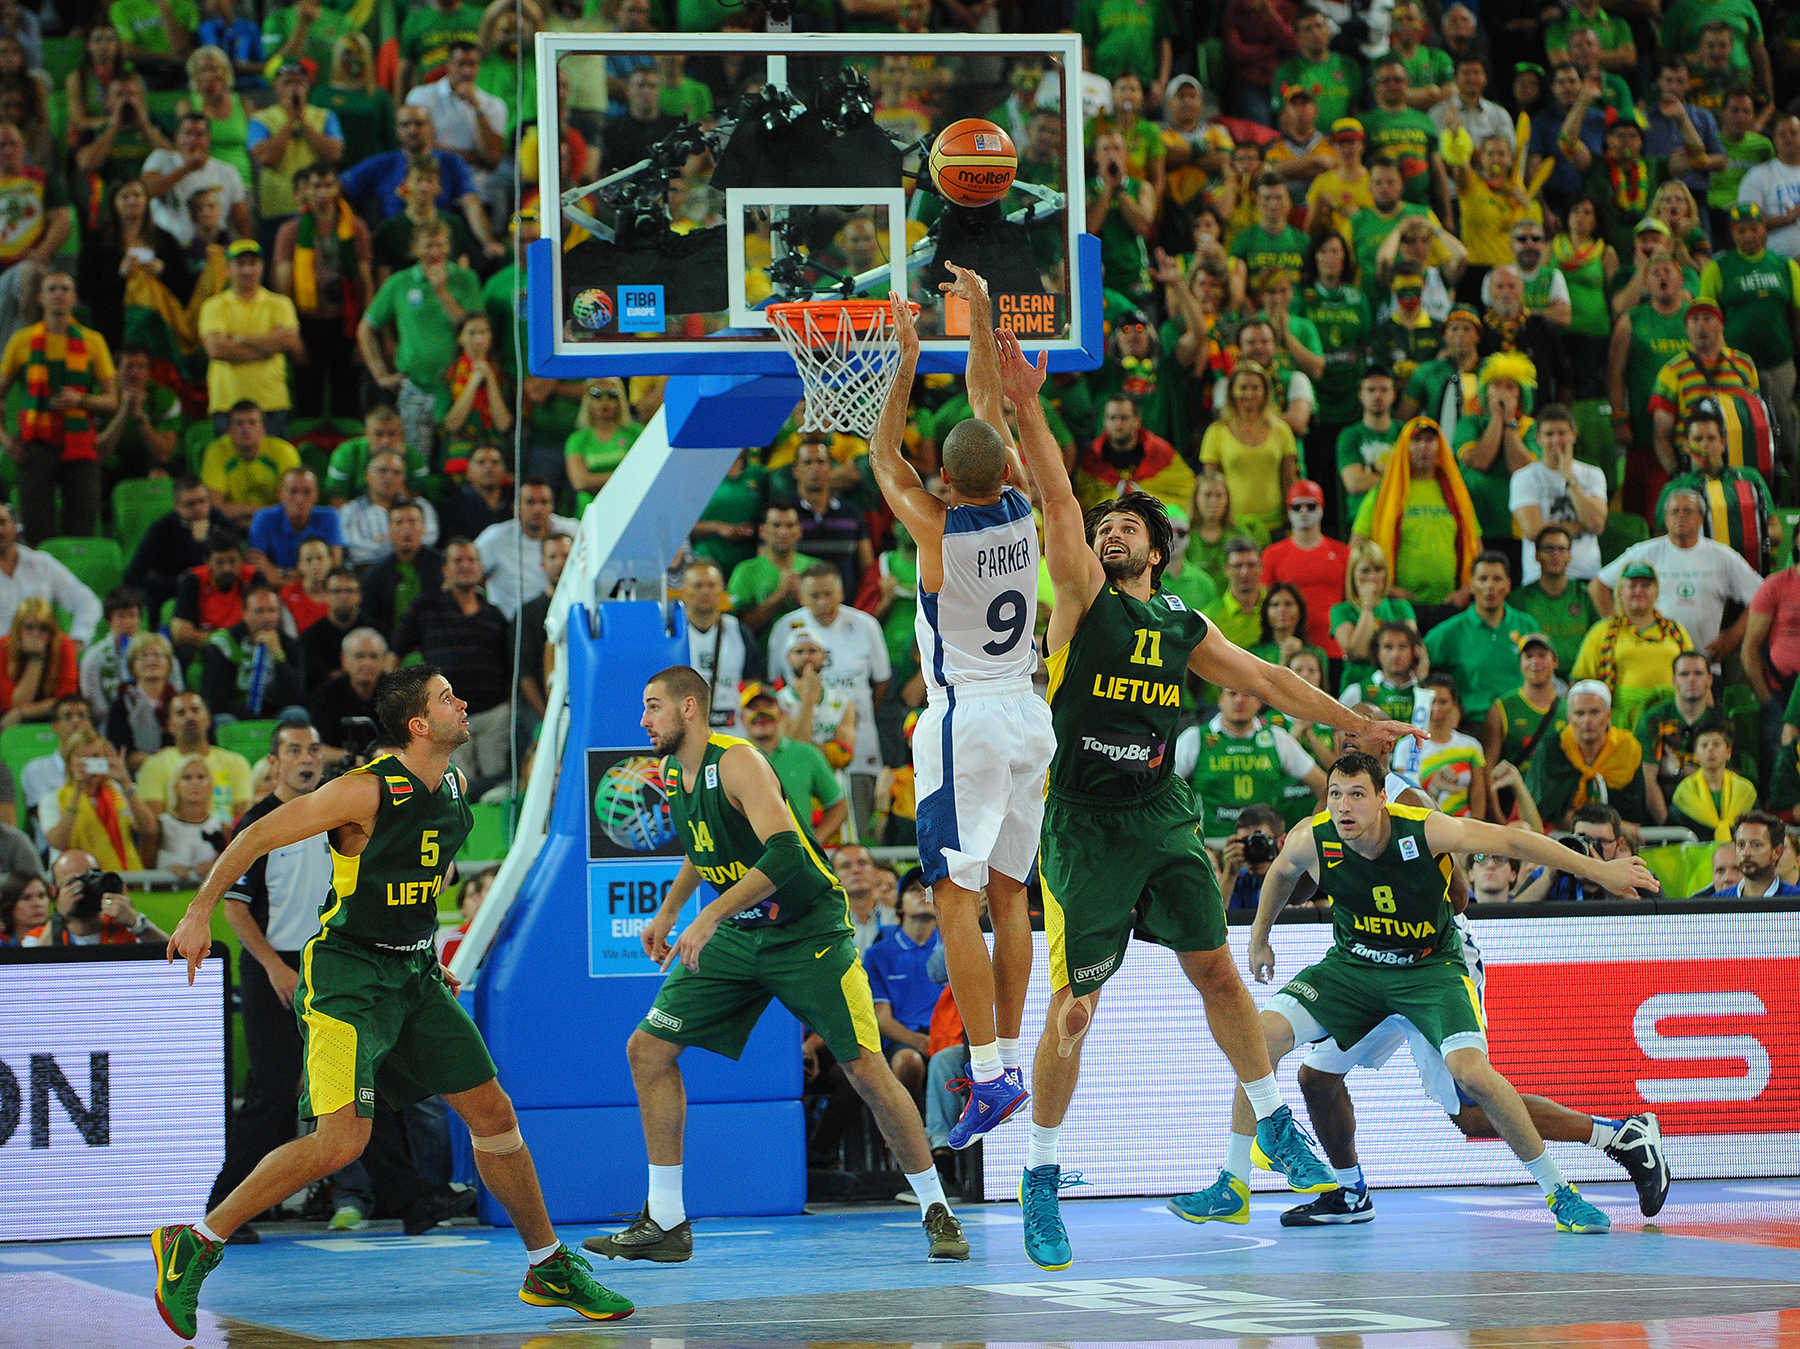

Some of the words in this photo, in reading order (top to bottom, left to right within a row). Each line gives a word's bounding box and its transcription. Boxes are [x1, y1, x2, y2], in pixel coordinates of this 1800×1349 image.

[958, 170, 1011, 185] molten
[625, 291, 657, 307] FIBA
[626, 307, 656, 317] EUROPE
[998, 293, 1055, 313] CLEAN
[999, 313, 1055, 334] GAME
[976, 537, 1031, 579] PARKER
[982, 589, 1028, 657] 9
[1130, 628, 1163, 668] 11
[1092, 673, 1181, 708] LIETUVA
[1081, 736, 1152, 762] TonyBet
[1208, 753, 1274, 772] LIETUVA
[1233, 774, 1254, 800] 10
[420, 829, 440, 868] 5
[687, 820, 715, 853] 14
[1371, 885, 1397, 914] 8
[1353, 914, 1437, 939] LIETUVA
[1350, 942, 1415, 965] TonyBet
[1632, 991, 1772, 1103] S
[0, 1051, 110, 1150] N
